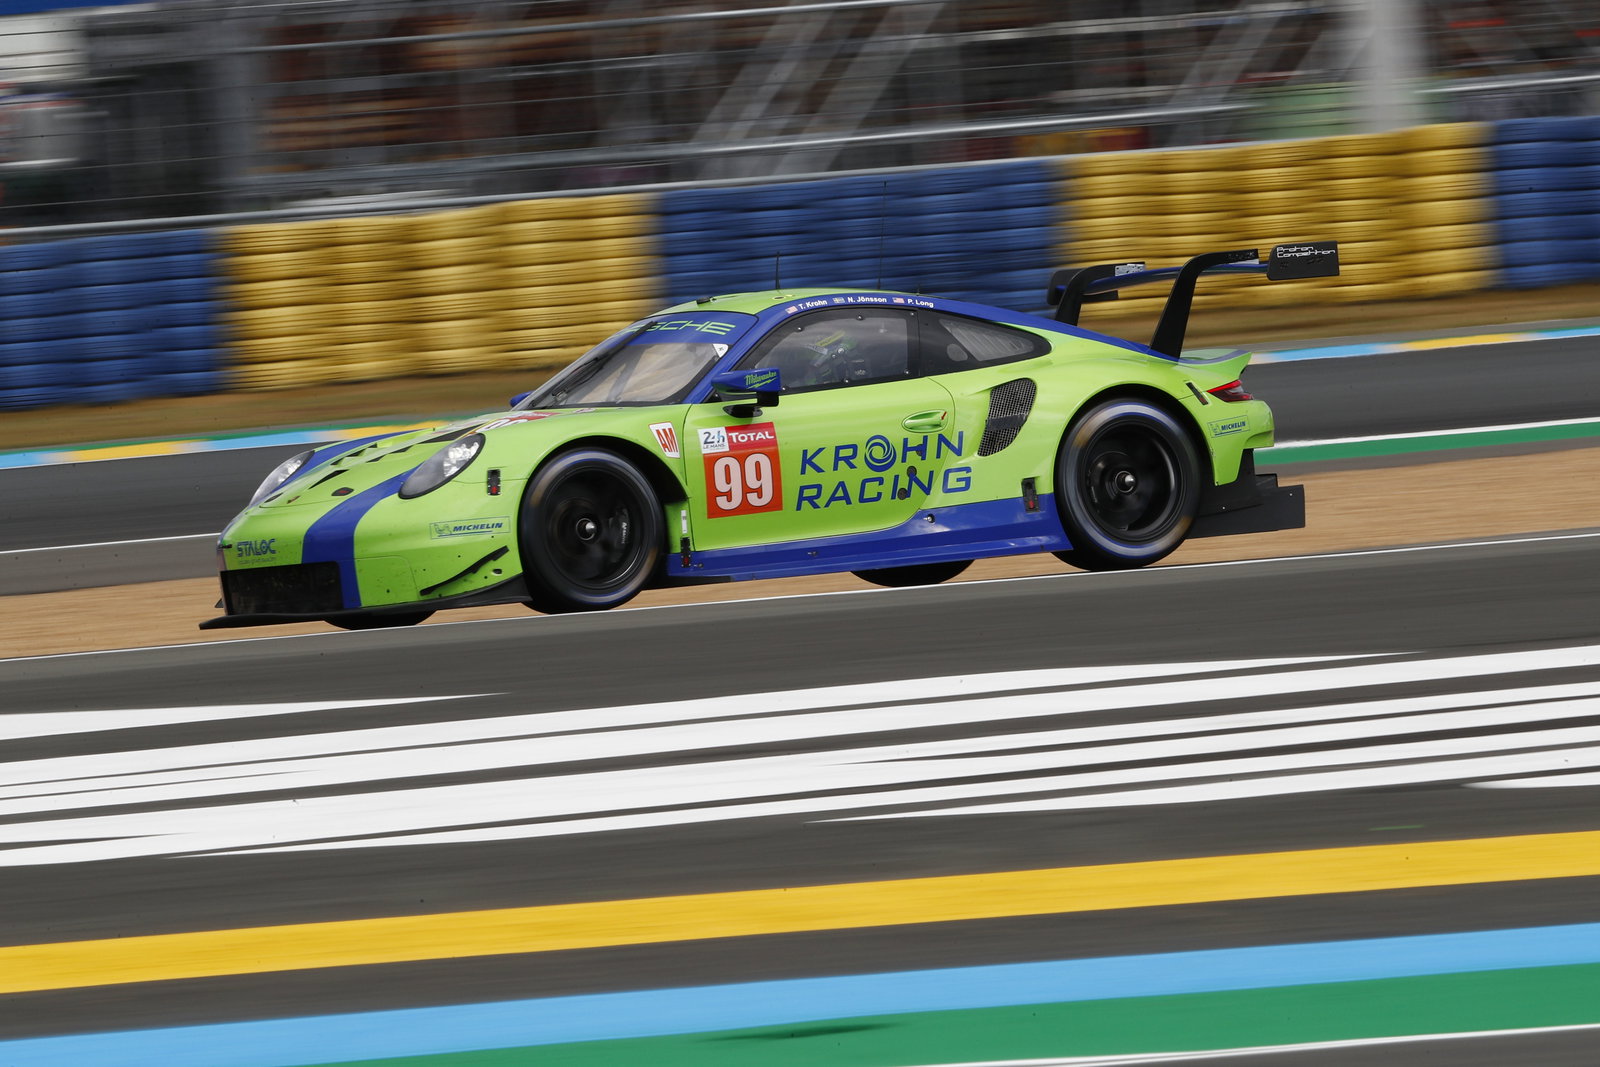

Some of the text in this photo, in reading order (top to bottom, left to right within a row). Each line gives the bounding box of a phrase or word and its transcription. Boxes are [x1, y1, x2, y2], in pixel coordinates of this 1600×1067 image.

[806, 299, 828, 309] Krohn
[915, 299, 934, 308] Long
[1221, 421, 1246, 431] MICHELIN
[655, 427, 679, 453] AM
[799, 430, 964, 475] KROHN
[713, 452, 774, 511] 99
[795, 465, 973, 511] RACING
[452, 522, 503, 532] MICHELIN
